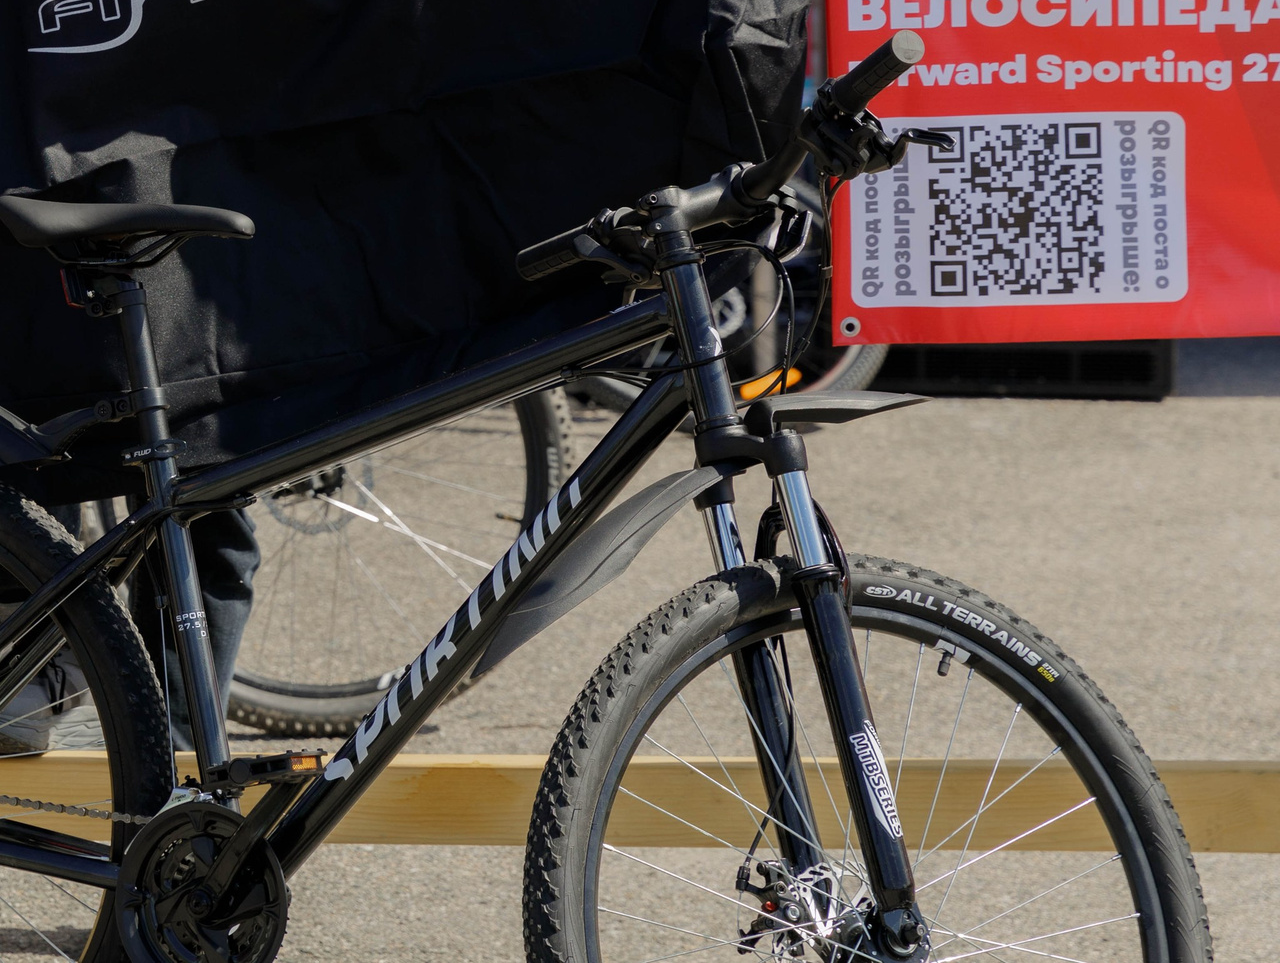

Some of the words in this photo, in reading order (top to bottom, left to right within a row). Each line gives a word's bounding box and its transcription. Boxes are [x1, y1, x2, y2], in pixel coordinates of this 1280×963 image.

[1036, 50, 1233, 92] Sporting
[1147, 119, 1171, 151] QR
[1150, 156, 1167, 199] код
[1113, 119, 1140, 293] розыгрыше:
[865, 219, 881, 261] код
[1153, 203, 1170, 271] поста
[862, 266, 884, 298] QR
[1155, 275, 1169, 289] о
[895, 589, 938, 611] ALL
[941, 600, 1043, 667] TERRAINS
